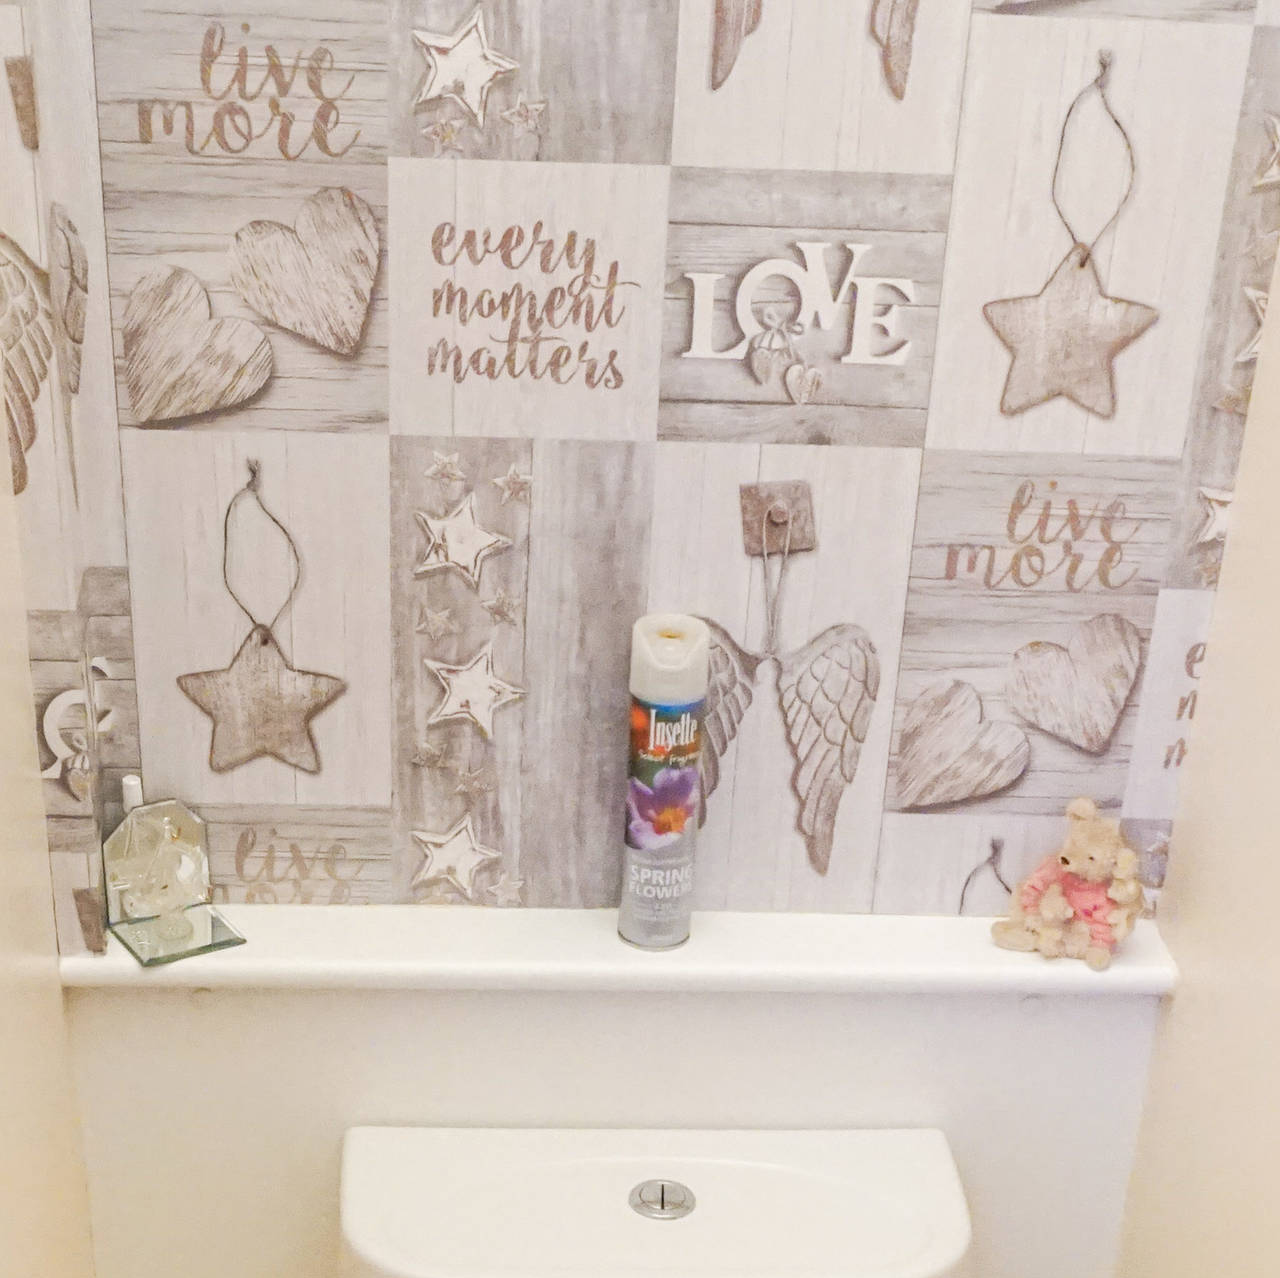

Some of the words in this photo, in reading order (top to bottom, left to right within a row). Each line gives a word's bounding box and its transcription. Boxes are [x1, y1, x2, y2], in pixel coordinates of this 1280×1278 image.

[200, 21, 356, 100] live
[138, 98, 361, 161] more
[431, 220, 596, 298] every
[433, 260, 642, 333] moment
[685, 241, 916, 364] LOVE
[427, 326, 624, 390] matters
[1007, 480, 1143, 544] live
[945, 539, 1139, 593] more
[235, 824, 365, 883] live
